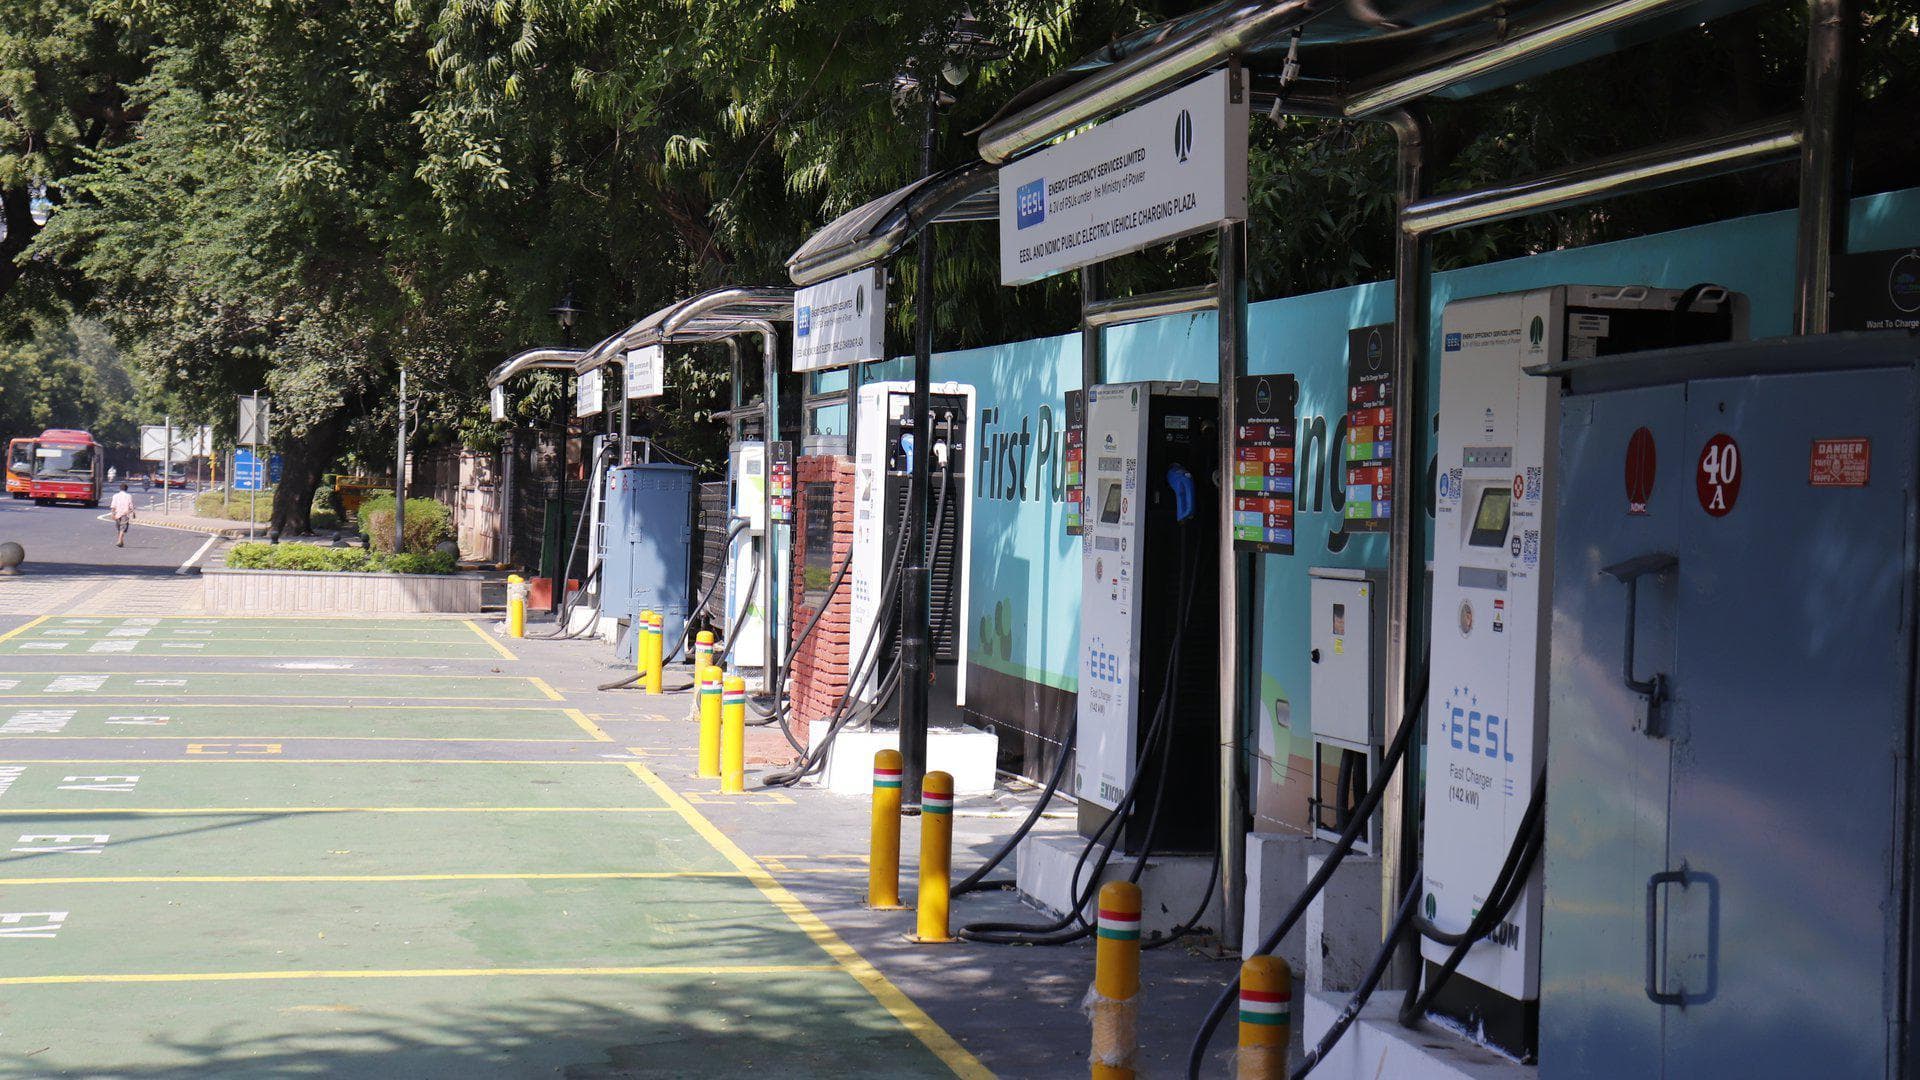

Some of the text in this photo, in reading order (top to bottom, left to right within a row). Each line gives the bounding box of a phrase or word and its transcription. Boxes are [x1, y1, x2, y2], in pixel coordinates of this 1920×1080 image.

[1048, 147, 1146, 196] ENERGY EFFICIENCY SERVICES LIMITED
[1101, 179, 1121, 196] Ministry
[1122, 173, 1128, 188] of
[1128, 170, 1146, 187] Power
[1021, 191, 1043, 217] EESL
[1019, 192, 1197, 264] EESL AND NDMC PUBLIC ELECTRIC VEHICLE CHARGING PLAZA
[1866, 318, 1920, 330] Want To Charge
[978, 405, 1030, 502] First
[1818, 443, 1863, 454] DANGER
[1703, 443, 1737, 485] 40
[1630, 502, 1646, 513] NDMC
[1709, 485, 1726, 510] A
[1091, 650, 1122, 684] EESL
[1450, 707, 1514, 763] EESL
[1450, 762, 1493, 790] Fast Charger
[1449, 785, 1480, 810] (142 kW)
